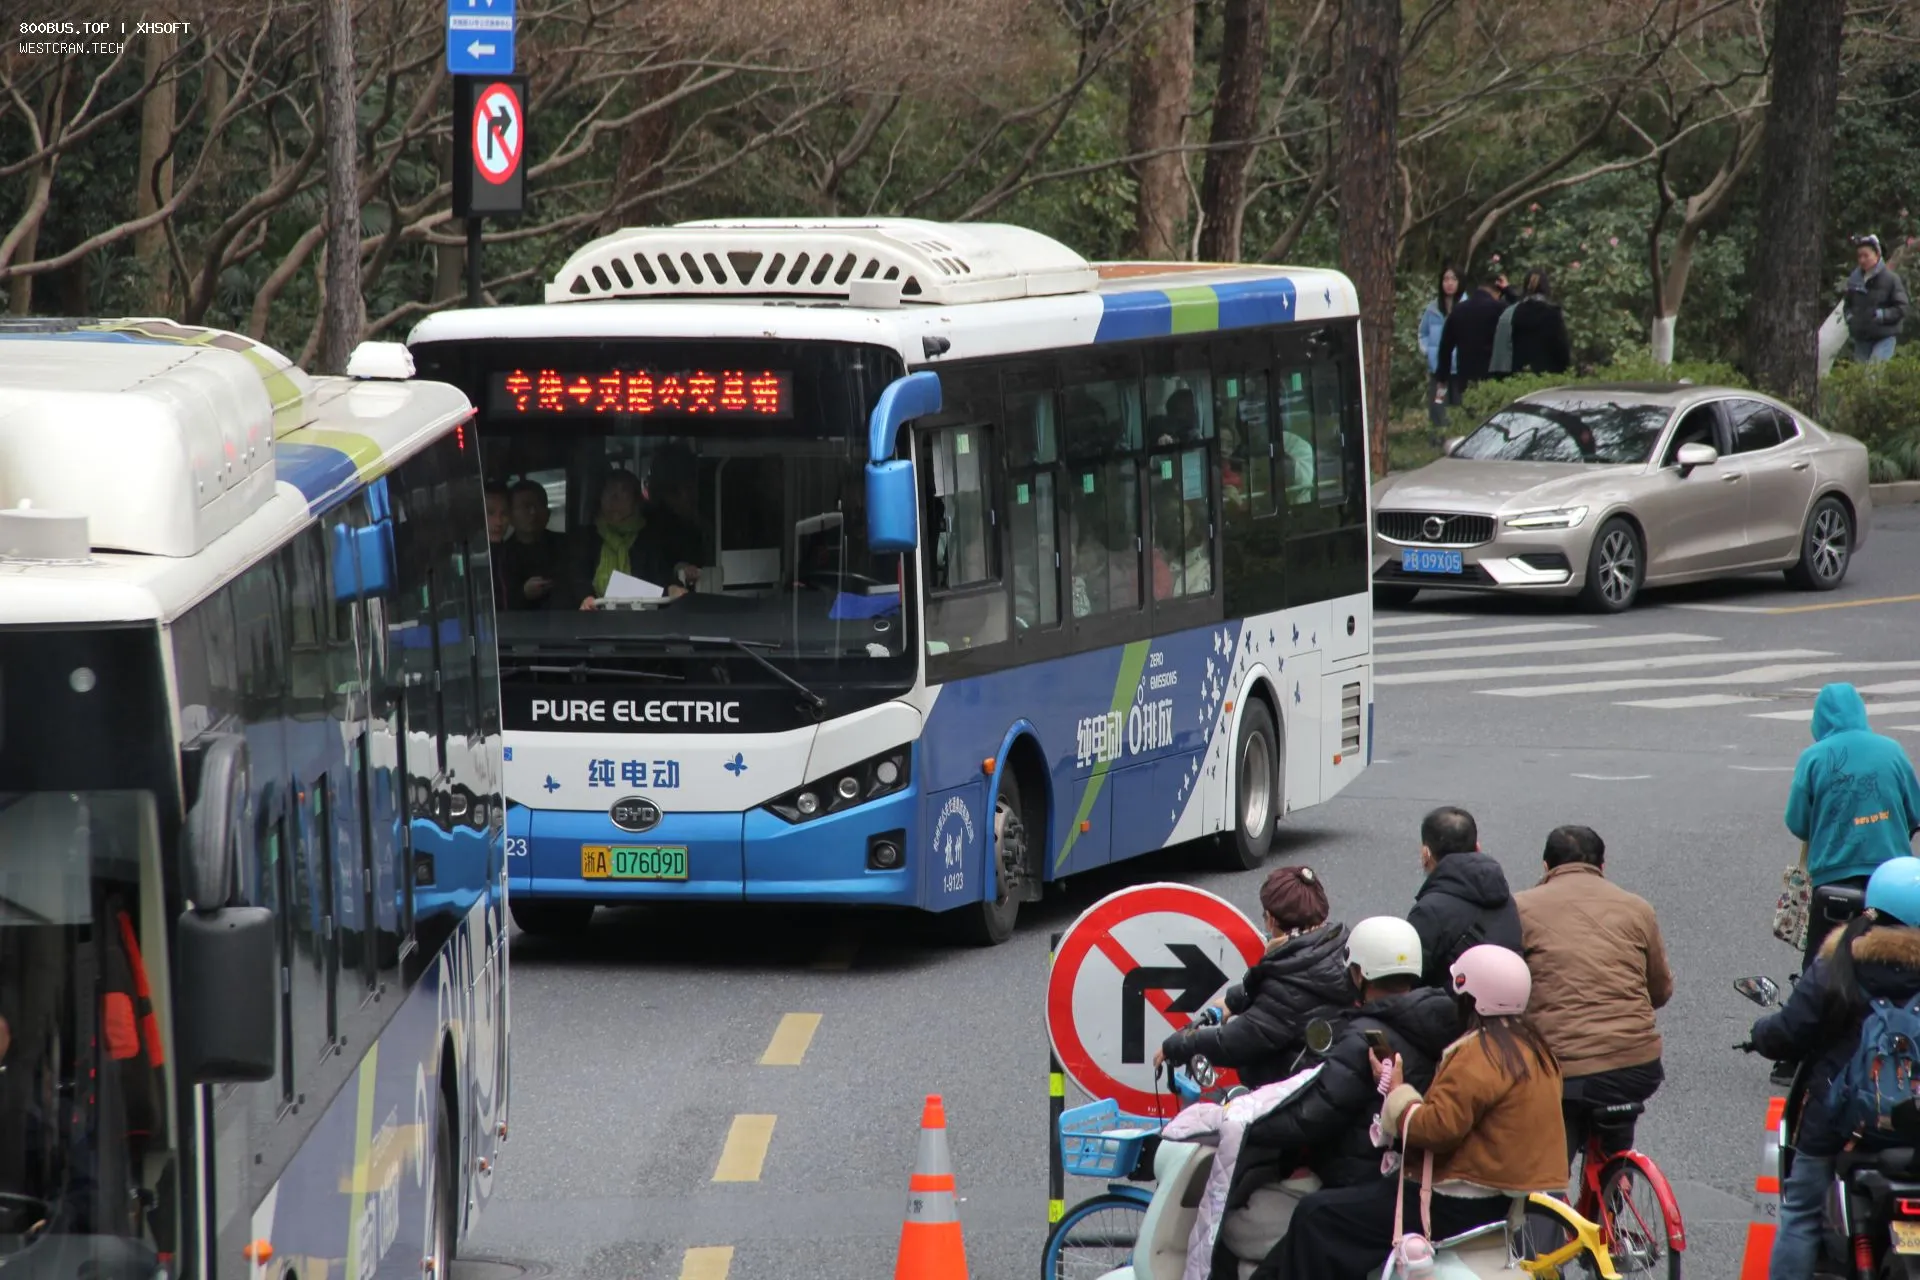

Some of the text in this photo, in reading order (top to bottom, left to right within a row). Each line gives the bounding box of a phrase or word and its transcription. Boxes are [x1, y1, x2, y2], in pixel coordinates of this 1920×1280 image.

[1149, 652, 1163, 668] ZERO
[1150, 671, 1177, 690] EMISSIONS
[532, 700, 740, 723] PURE ELECTRIC
[1076, 710, 1122, 768] 纯电动
[588, 759, 680, 788] 纯电动
[615, 806, 655, 822] BYD
[944, 827, 963, 869] 杭州
[943, 871, 964, 893] 1-9123
